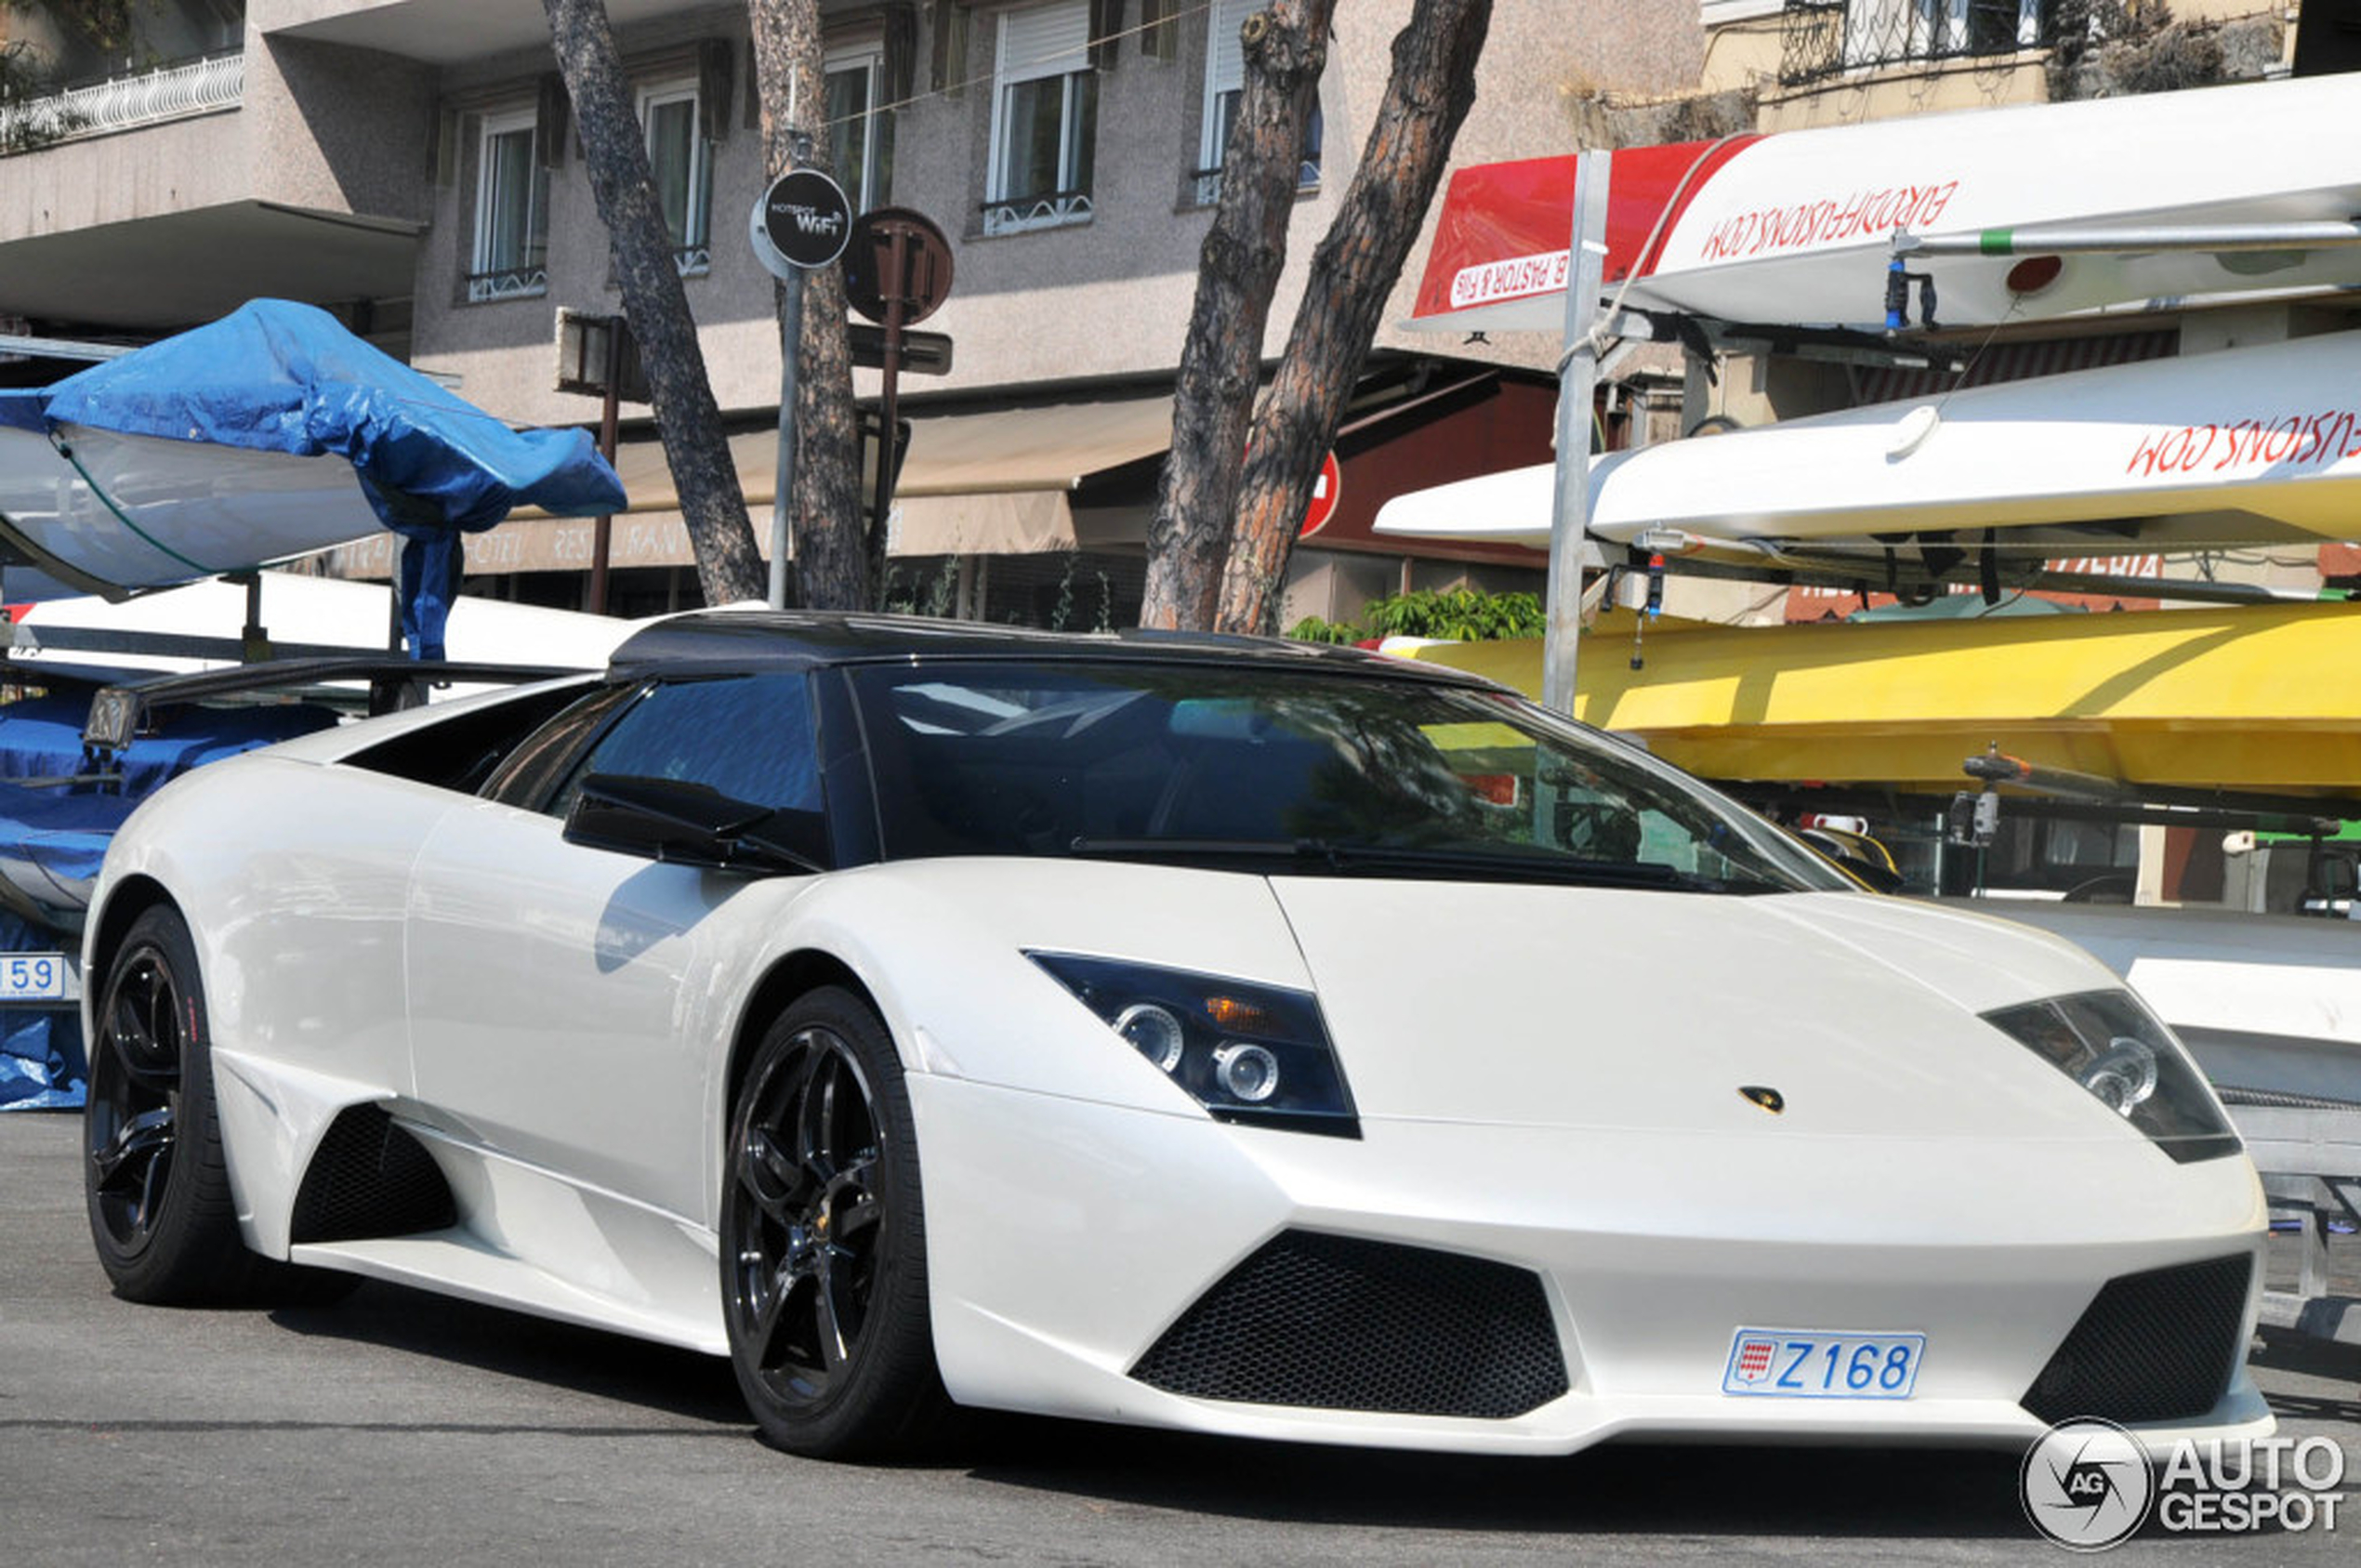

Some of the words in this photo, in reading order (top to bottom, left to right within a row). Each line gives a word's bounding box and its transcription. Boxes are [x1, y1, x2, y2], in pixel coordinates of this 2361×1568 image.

[1701, 181, 1959, 261] EURODIFFUSIONS.COM
[1493, 257, 1551, 293] PASTOR
[554, 521, 690, 560] RESURANT
[1776, 1341, 1911, 1390] Z168
